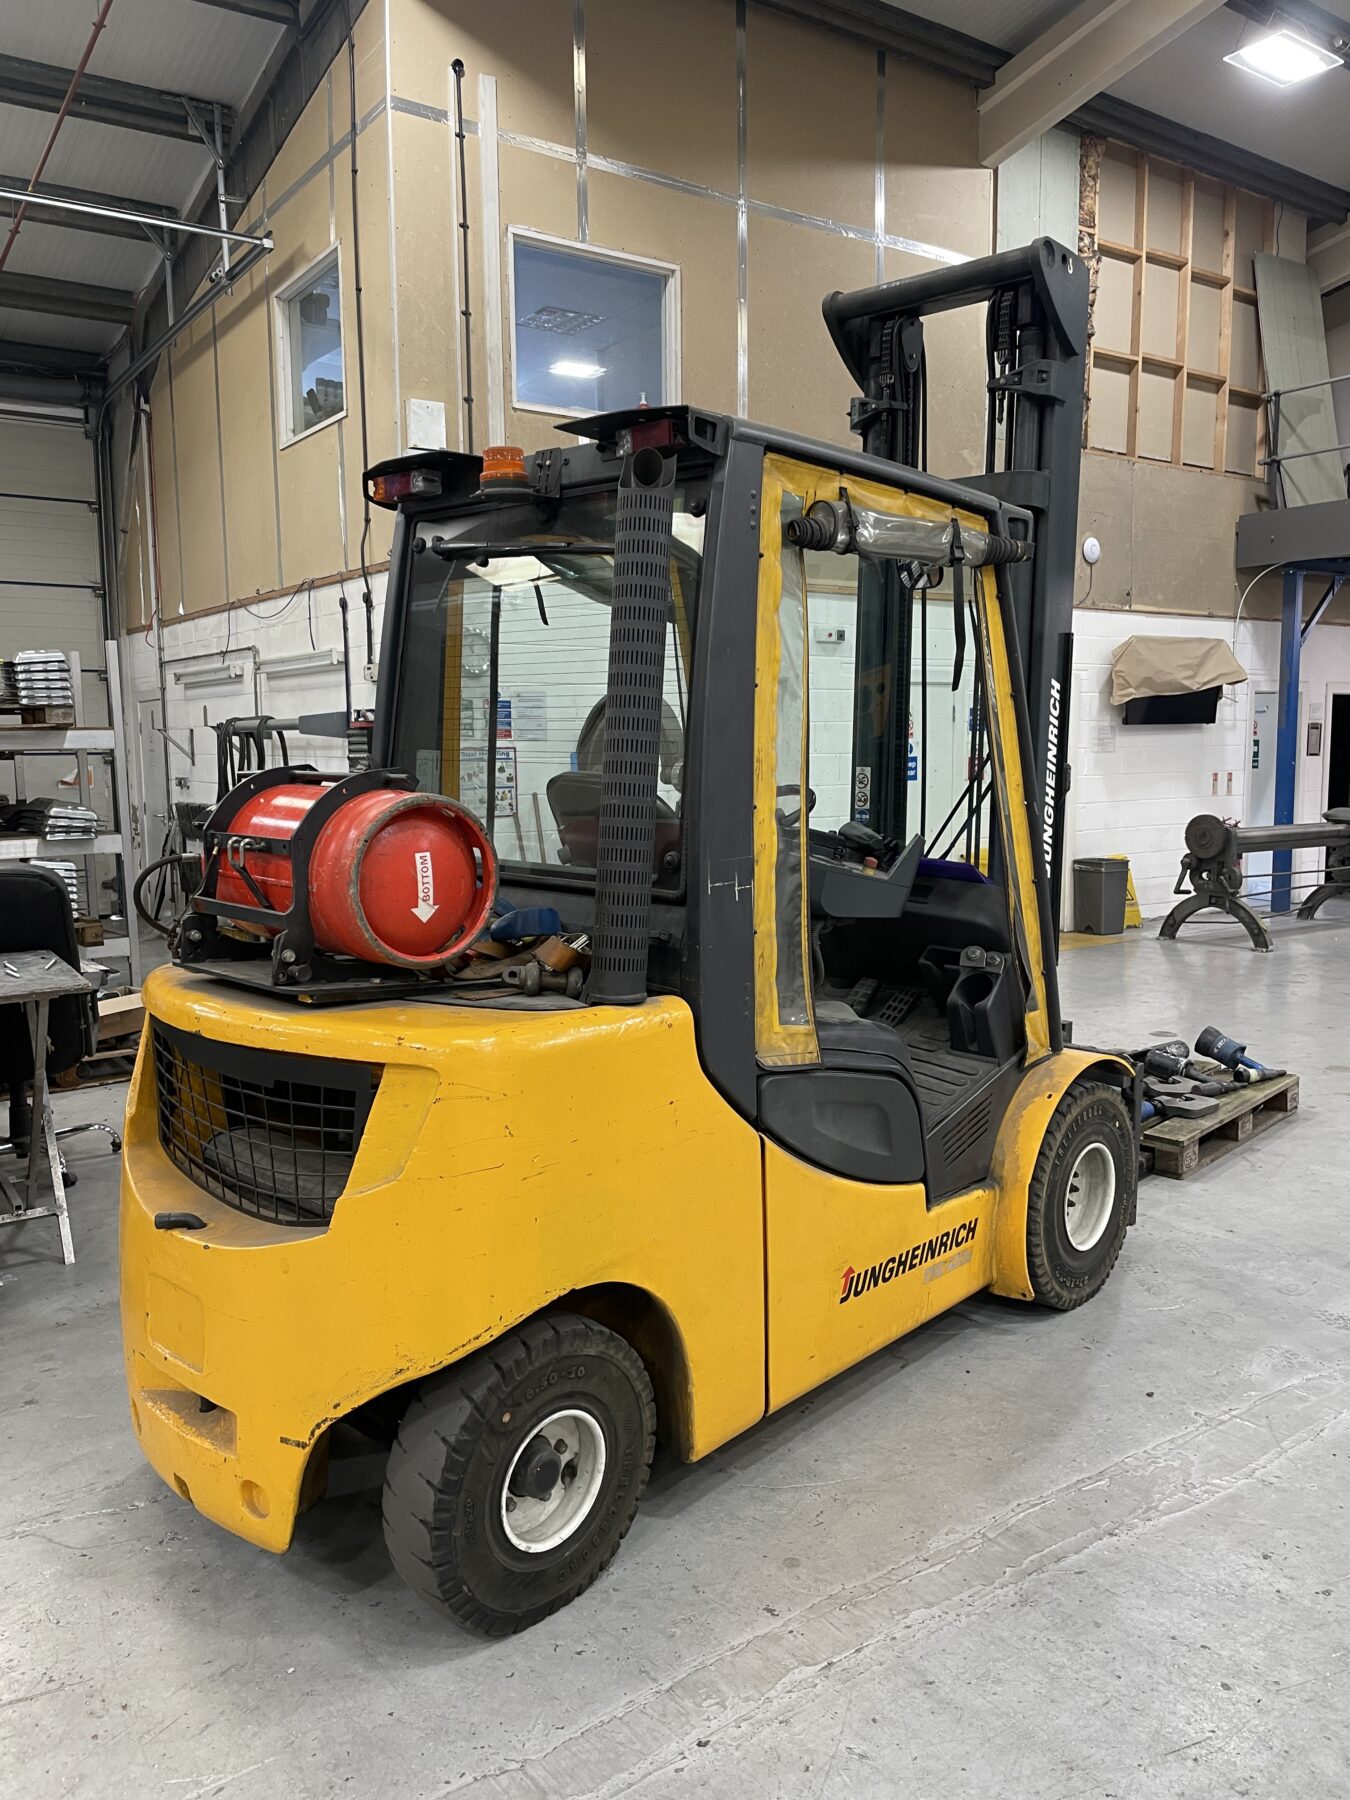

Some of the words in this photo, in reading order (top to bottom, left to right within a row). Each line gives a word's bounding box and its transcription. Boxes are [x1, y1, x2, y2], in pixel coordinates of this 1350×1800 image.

[1043, 678, 1061, 879] JUNGHEINRICH
[420, 855, 430, 902] BOTTOM
[839, 1217, 979, 1304] JUNGHEINRICH
